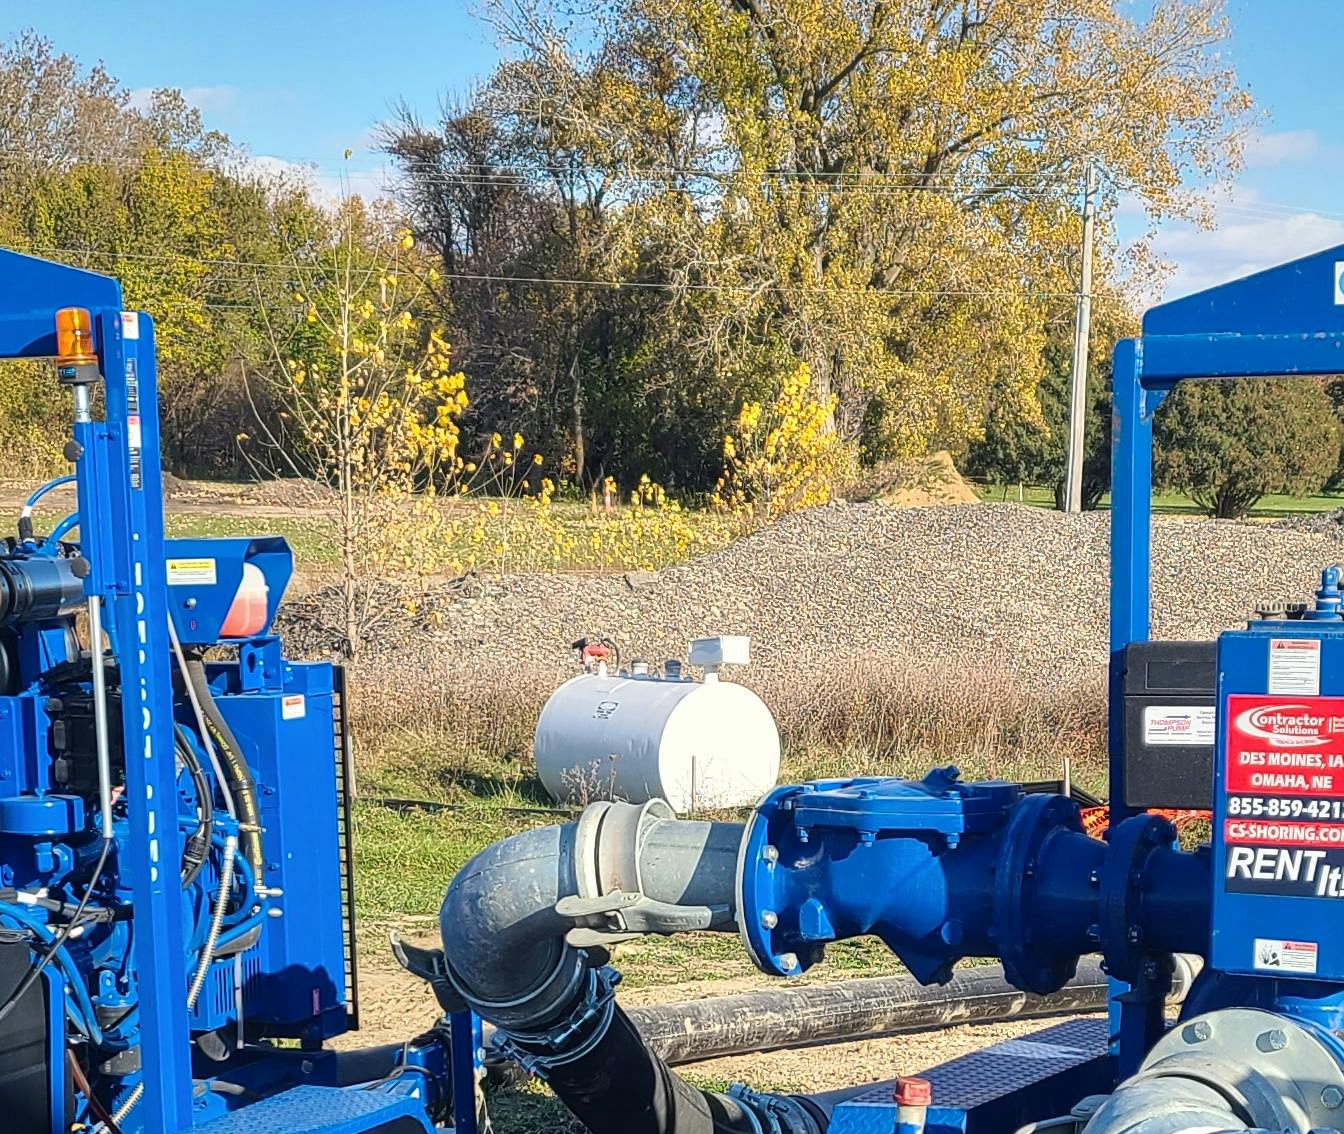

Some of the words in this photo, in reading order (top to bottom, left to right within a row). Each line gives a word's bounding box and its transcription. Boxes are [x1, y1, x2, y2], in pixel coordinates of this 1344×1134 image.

[1245, 709, 1325, 731] Contractor
[1272, 725, 1320, 735] Solutions
[1239, 751, 1266, 765] DES
[1268, 752, 1326, 769] MOINES,
[1328, 754, 1344, 768] IA
[1251, 773, 1310, 790] OMAHA,
[1312, 775, 1333, 789] NE
[1227, 846, 1327, 882] RENT
